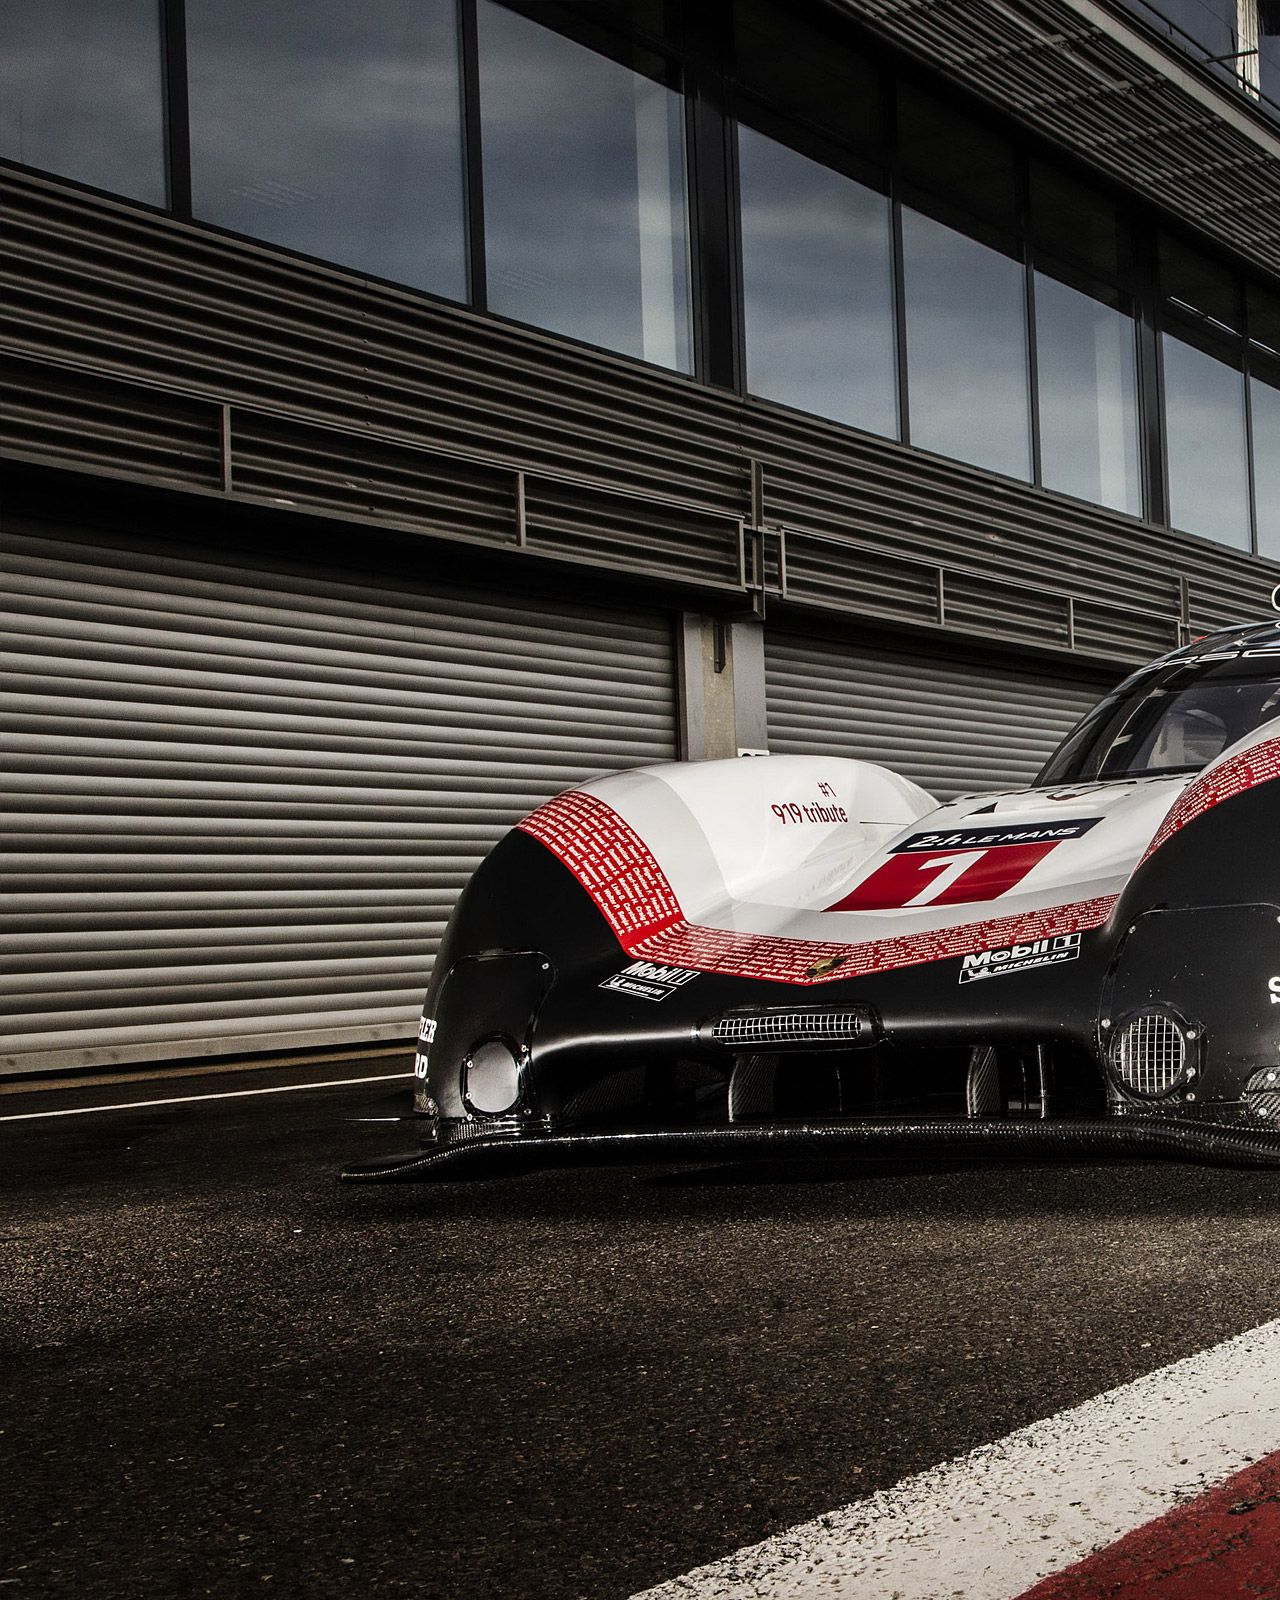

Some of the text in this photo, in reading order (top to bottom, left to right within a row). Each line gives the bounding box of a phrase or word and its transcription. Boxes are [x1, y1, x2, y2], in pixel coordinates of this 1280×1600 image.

[817, 782, 837, 798] #1
[771, 802, 848, 824] 919 tribute
[962, 835, 1001, 845] LE
[998, 827, 1081, 842] MANS
[901, 850, 989, 906] 1
[962, 939, 1049, 969] Mobil
[993, 951, 1070, 973] MICHELIN
[620, 960, 684, 983] Mobil
[621, 982, 665, 996] MICHELIN
